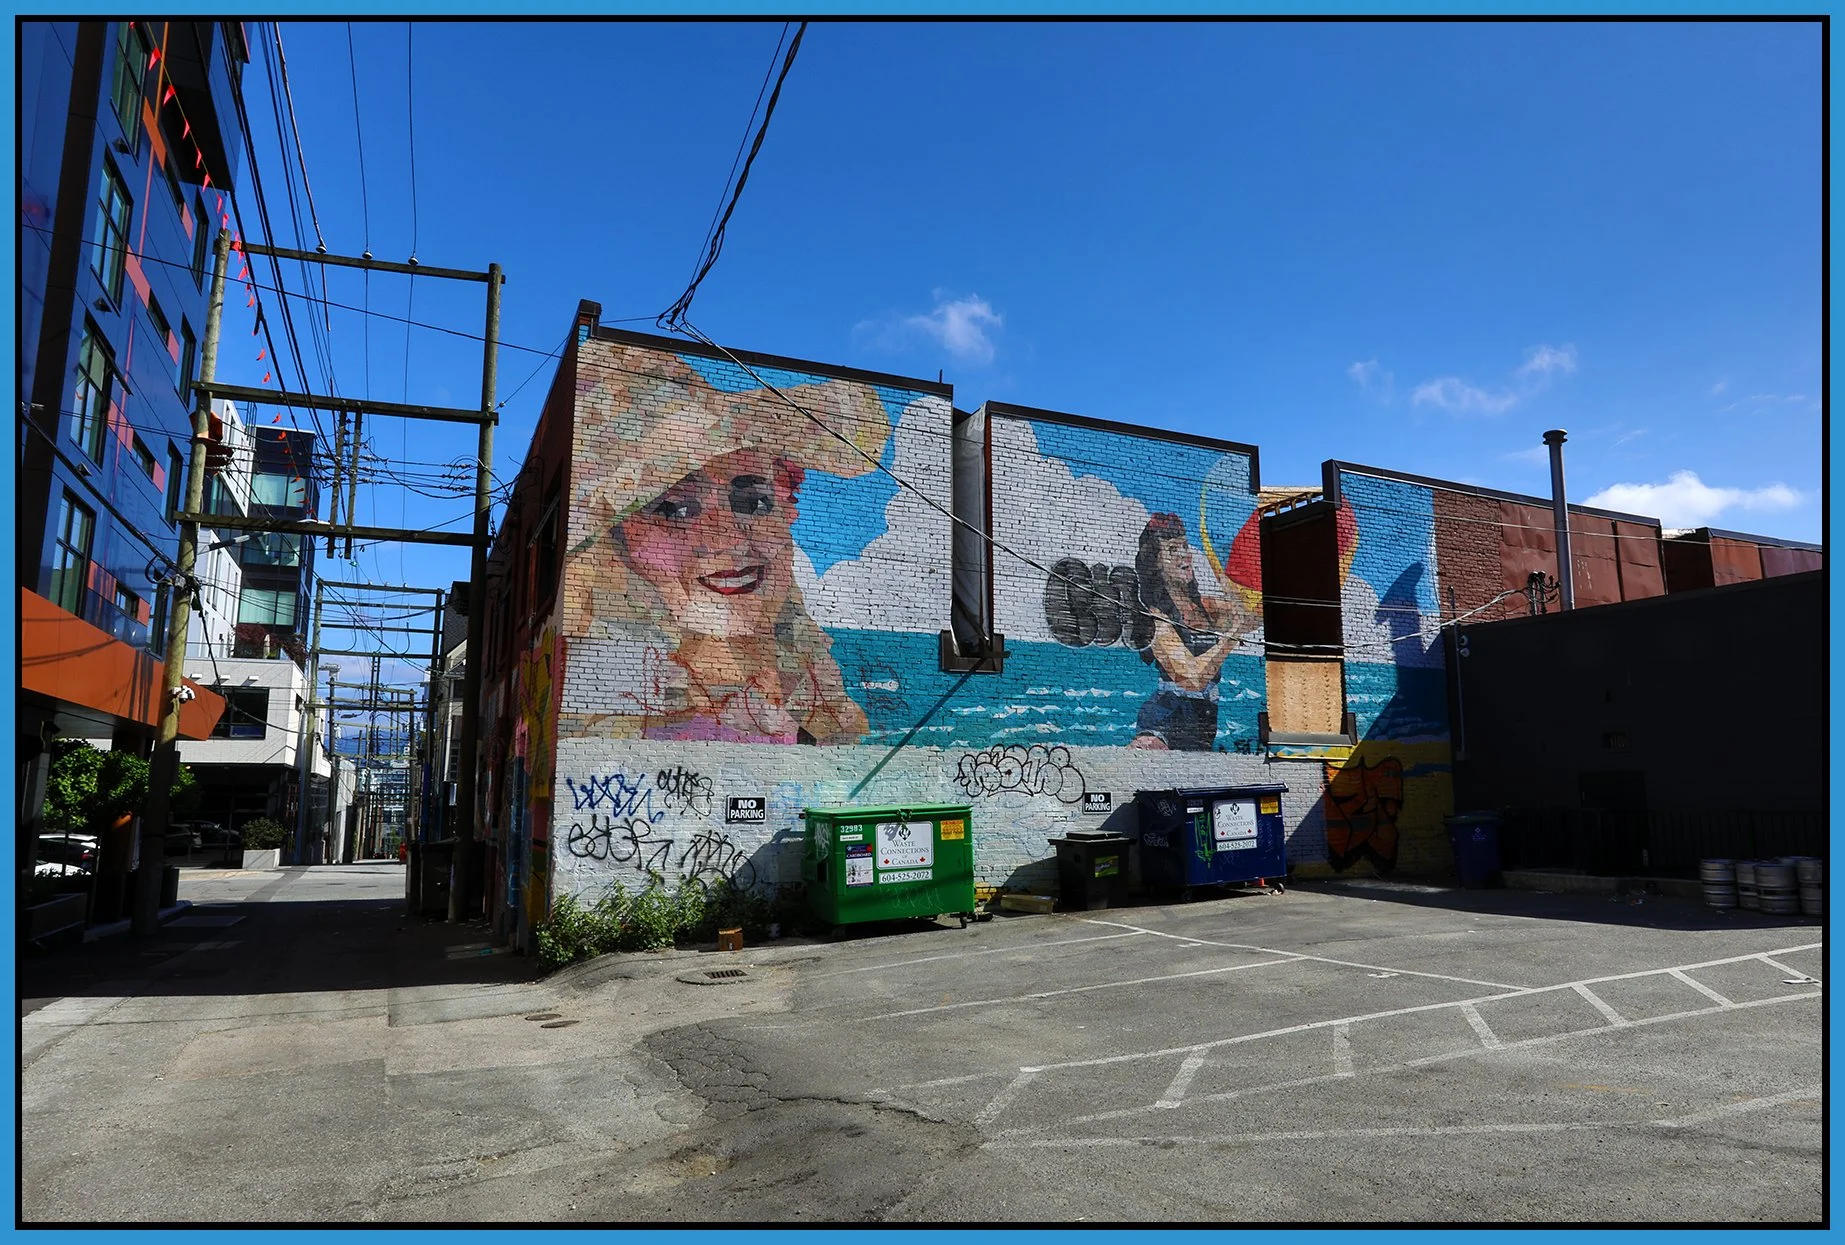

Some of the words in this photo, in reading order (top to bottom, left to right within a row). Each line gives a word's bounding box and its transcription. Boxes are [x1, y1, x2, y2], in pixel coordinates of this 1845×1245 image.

[1090, 794, 1105, 802] NO
[738, 799, 757, 809] NO
[1085, 803, 1111, 811] PARKING
[730, 809, 764, 819] PARKING
[840, 825, 863, 833] 32983
[1218, 841, 1255, 850] 604-525-2072
[880, 847, 930, 855] CONNECTIONS
[881, 872, 930, 882] 604-525-2072
